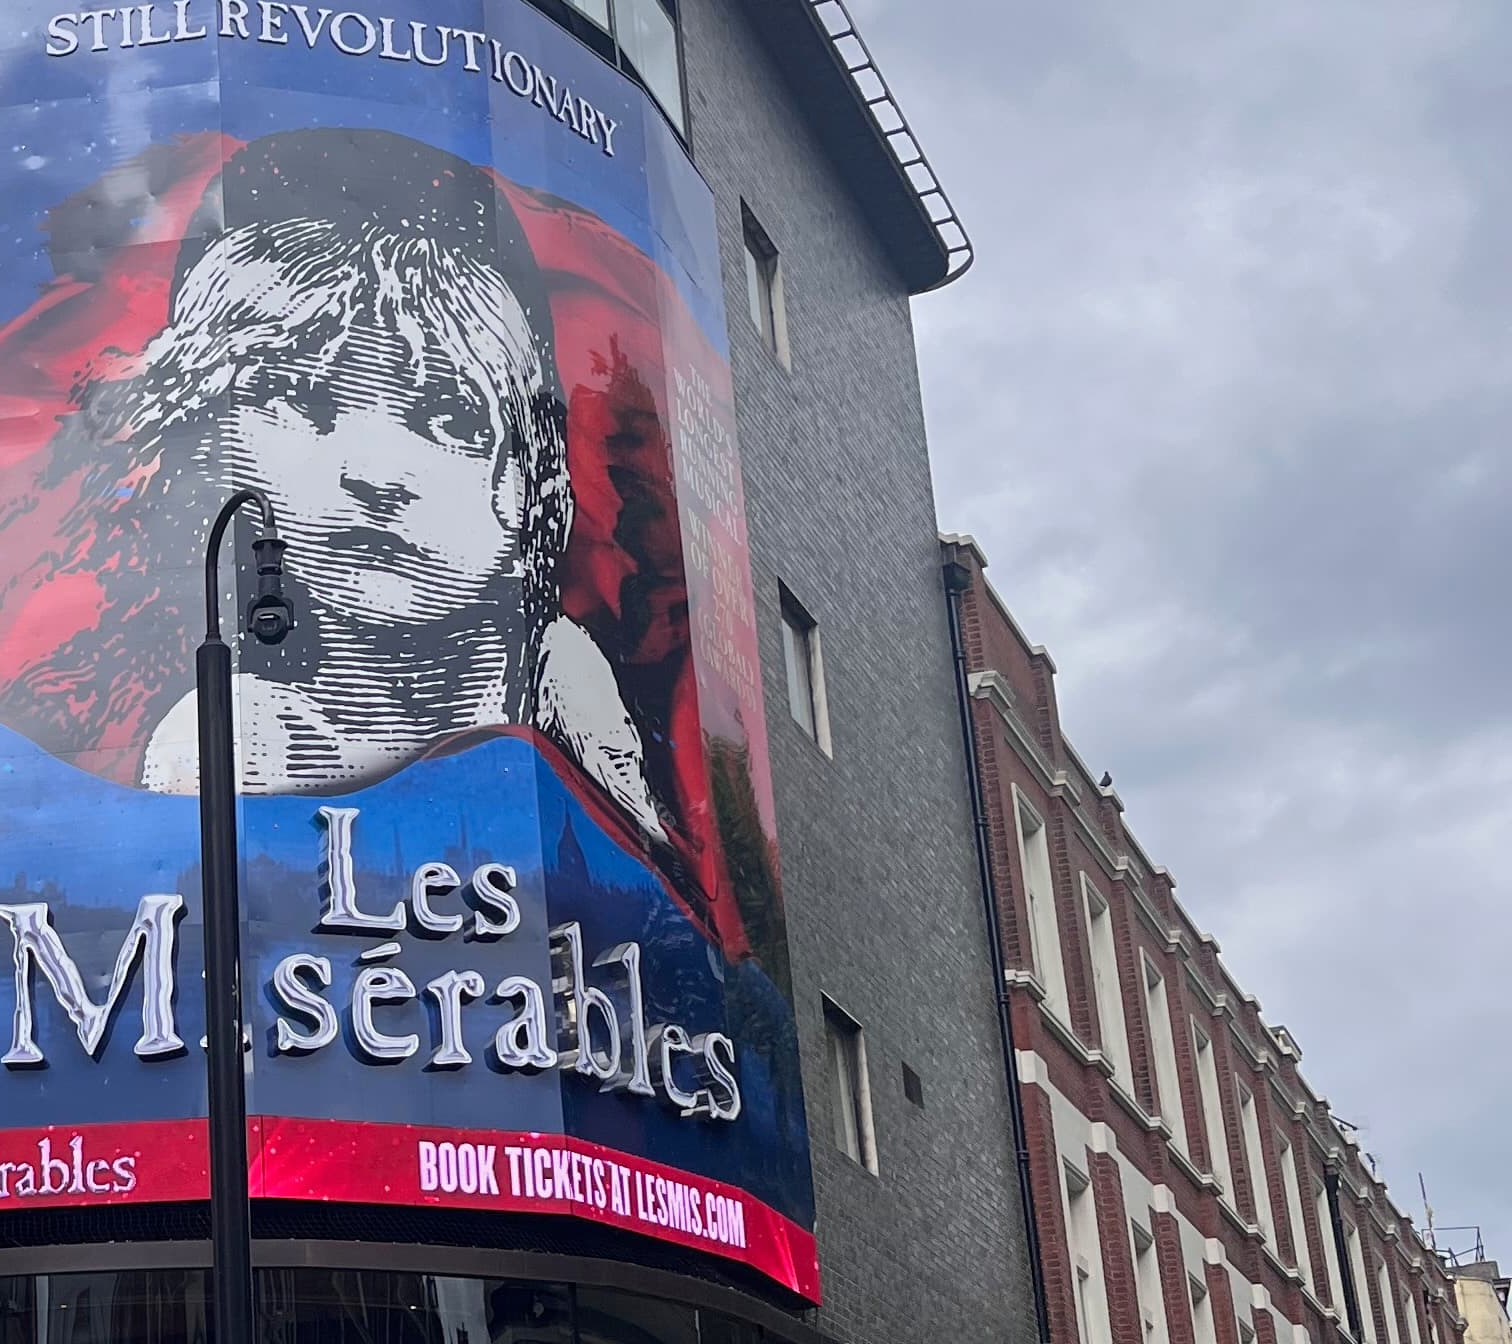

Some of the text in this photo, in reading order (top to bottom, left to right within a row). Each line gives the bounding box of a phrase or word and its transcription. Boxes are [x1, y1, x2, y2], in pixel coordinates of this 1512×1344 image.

[315, 805, 522, 936] Les
[419, 1141, 746, 1248] BOOK TICKETS AT LESMIS.COM
